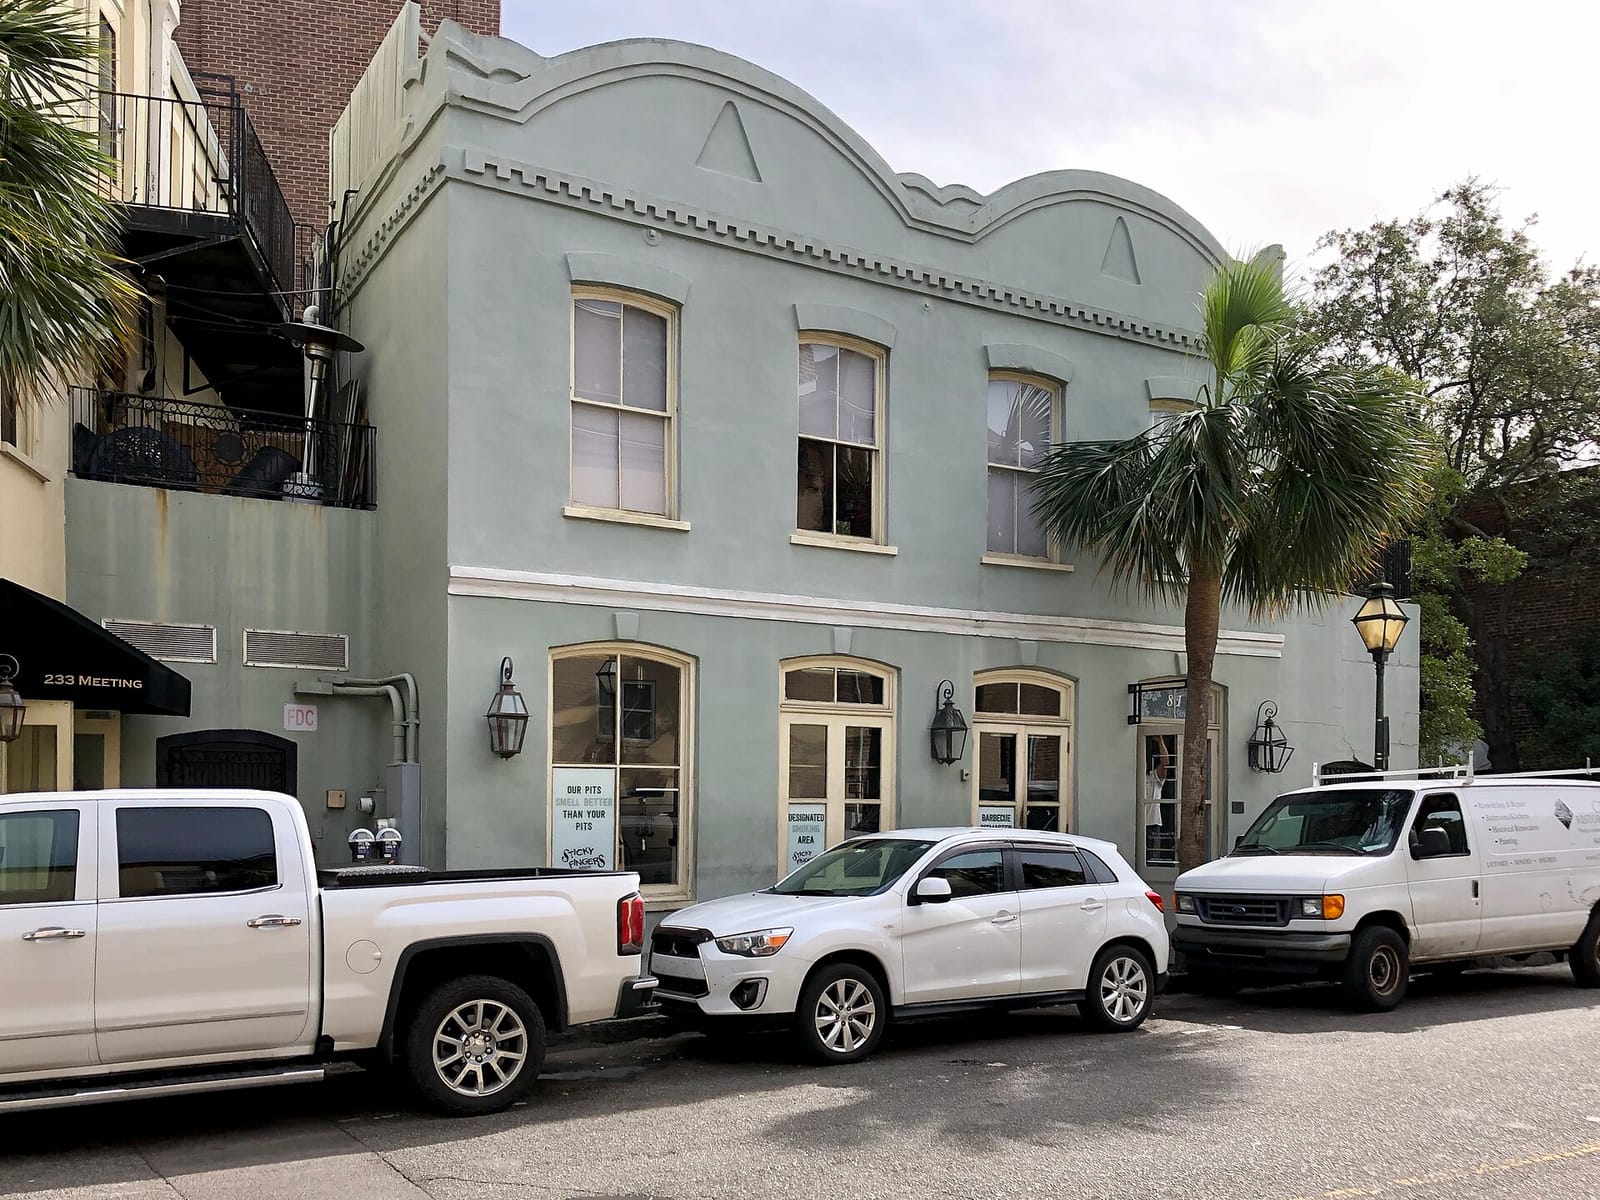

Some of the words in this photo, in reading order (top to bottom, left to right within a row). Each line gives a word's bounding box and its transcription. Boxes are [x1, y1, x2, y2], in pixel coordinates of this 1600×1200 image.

[44, 674, 75, 685] 233
[78, 675, 143, 689] MEETING
[287, 709, 314, 726] FDC
[567, 785, 582, 795] OUR
[584, 786, 602, 795] PITS
[555, 798, 580, 807] SMELL
[583, 798, 613, 807] BETTER
[563, 809, 583, 819] THAN
[586, 810, 606, 819] YOUR
[787, 813, 825, 822] DESIGNATED
[981, 813, 1012, 822] BARBECUE
[575, 822, 593, 831] PITS
[791, 824, 820, 833] SMOKING
[797, 835, 815, 844] AREA
[561, 847, 594, 863] STICKY
[568, 854, 606, 869] FINGERS
